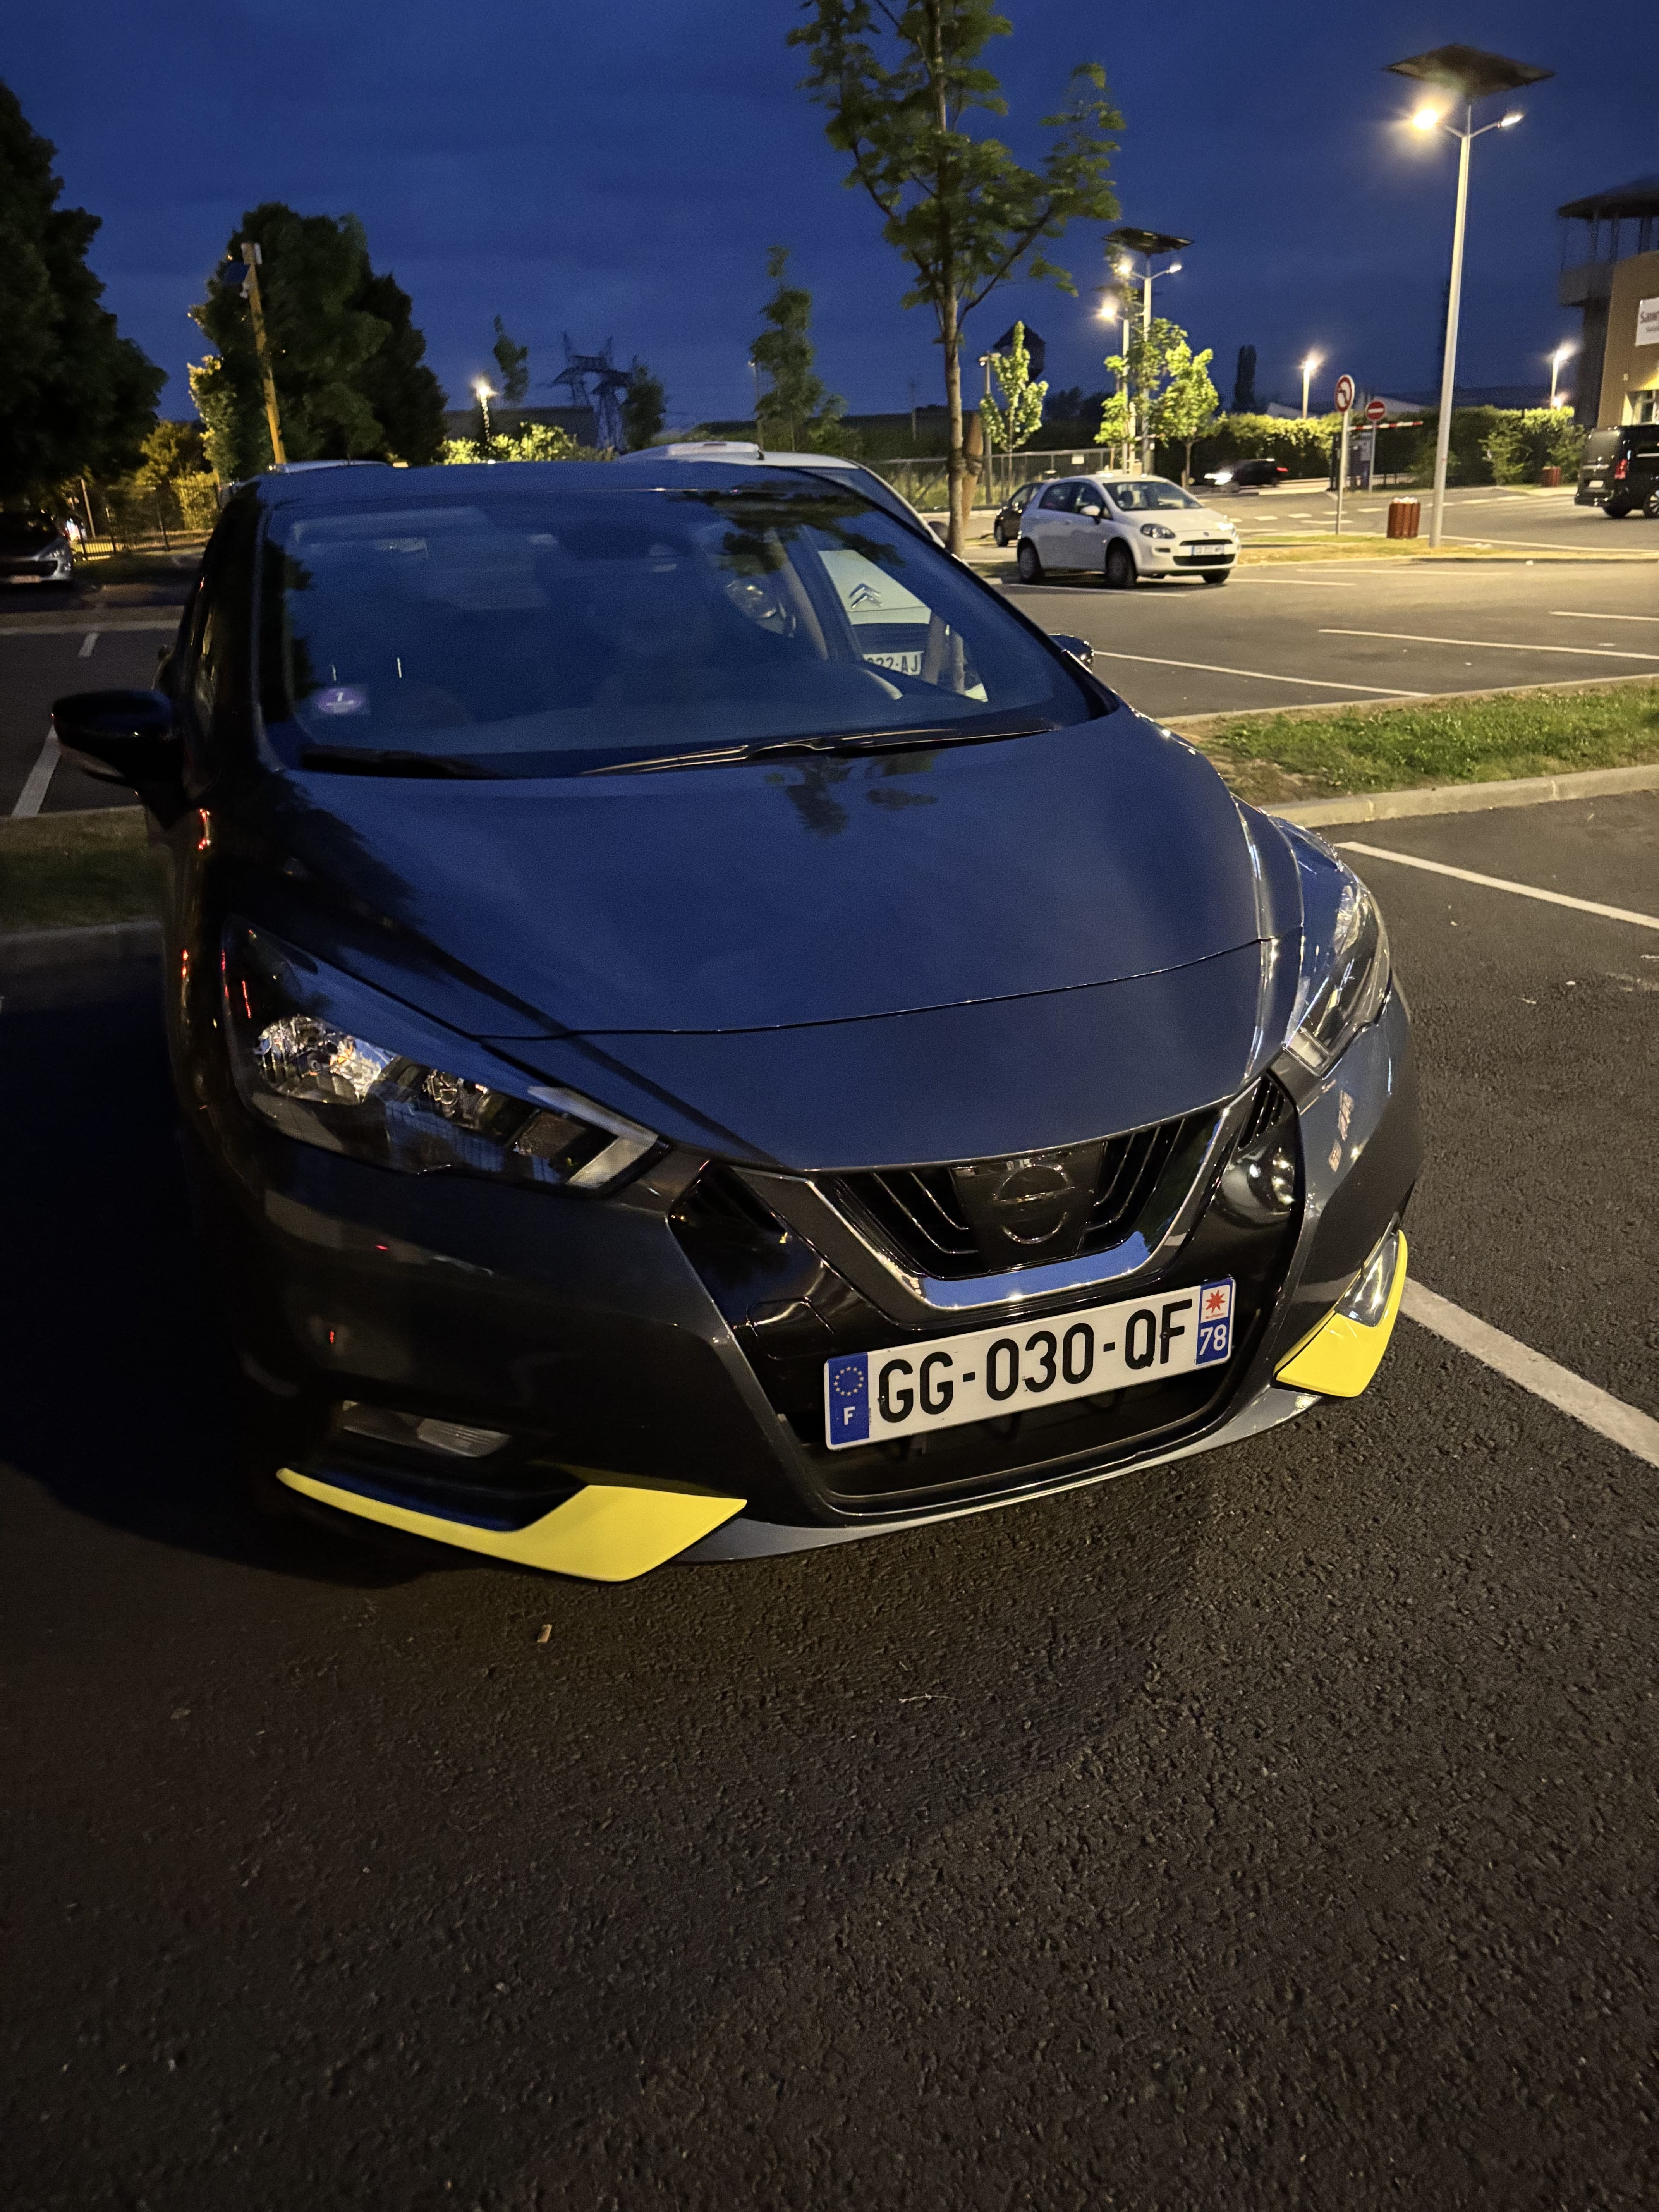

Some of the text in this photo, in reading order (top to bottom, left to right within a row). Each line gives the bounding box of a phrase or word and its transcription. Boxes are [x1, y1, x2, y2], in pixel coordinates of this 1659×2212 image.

[1200, 1324, 1227, 1355] 78
[879, 1299, 1192, 1423] GG-030-QF
[843, 1407, 855, 1425] F
